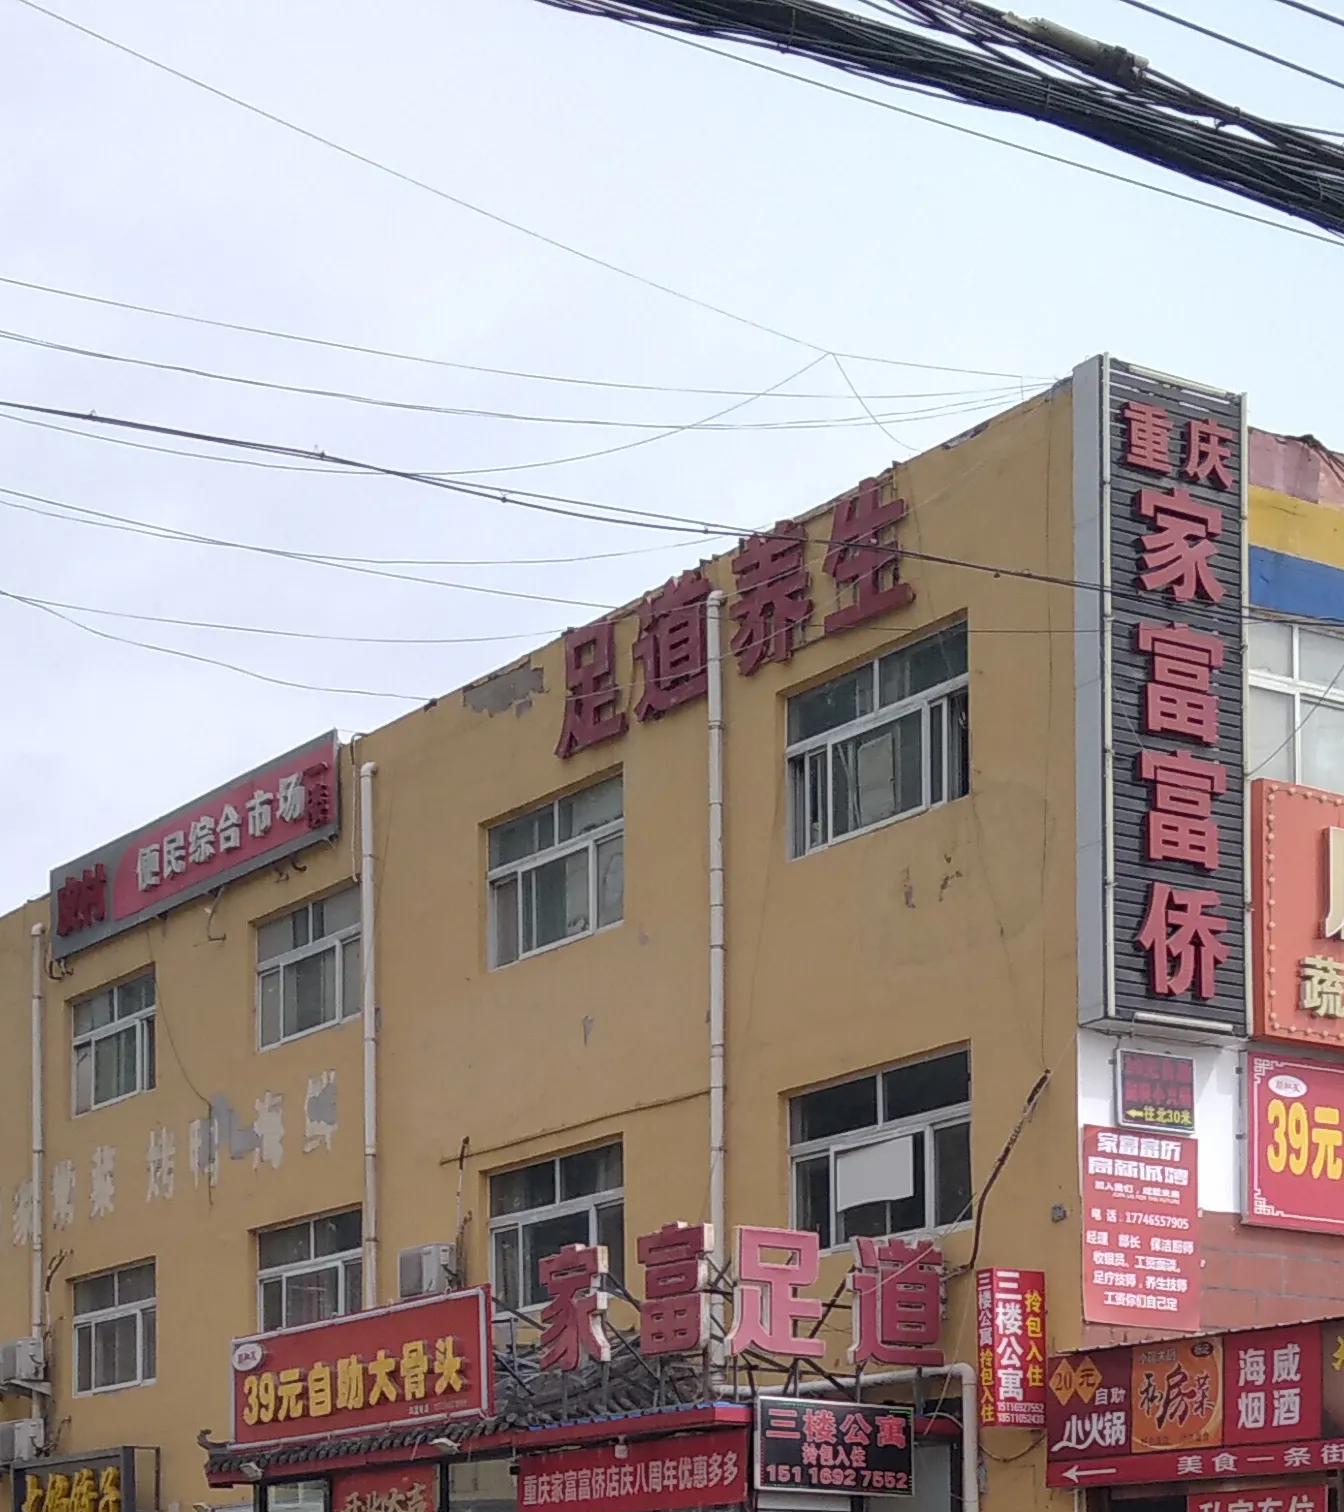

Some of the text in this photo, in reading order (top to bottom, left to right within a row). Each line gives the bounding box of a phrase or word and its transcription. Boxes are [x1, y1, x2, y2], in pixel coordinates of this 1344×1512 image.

[1122, 401, 1233, 488] 重庆
[555, 477, 915, 759] 足道养生
[1134, 487, 1229, 999] 家富富侨
[137, 771, 306, 891] 便民综合市场
[1118, 1234, 1141, 1248] 部长
[538, 1221, 946, 1373] 家富足道
[978, 1272, 993, 1346] 三楼公寓
[995, 1271, 1024, 1401] 三楼公寓
[1024, 1289, 1044, 1387] 拎包入住
[1238, 1343, 1301, 1387] 海威
[243, 1336, 463, 1426] 39元自助大骨头
[1139, 1363, 1215, 1431] 私房菜
[1237, 1388, 1301, 1430] 烟酒
[766, 1408, 906, 1449] 三楼公寓
[802, 1443, 867, 1467] 拎包入住
[1051, 1411, 1126, 1452] 小火锅
[523, 1451, 738, 1506] 重庆家富富侨店庆八周年优惠多多
